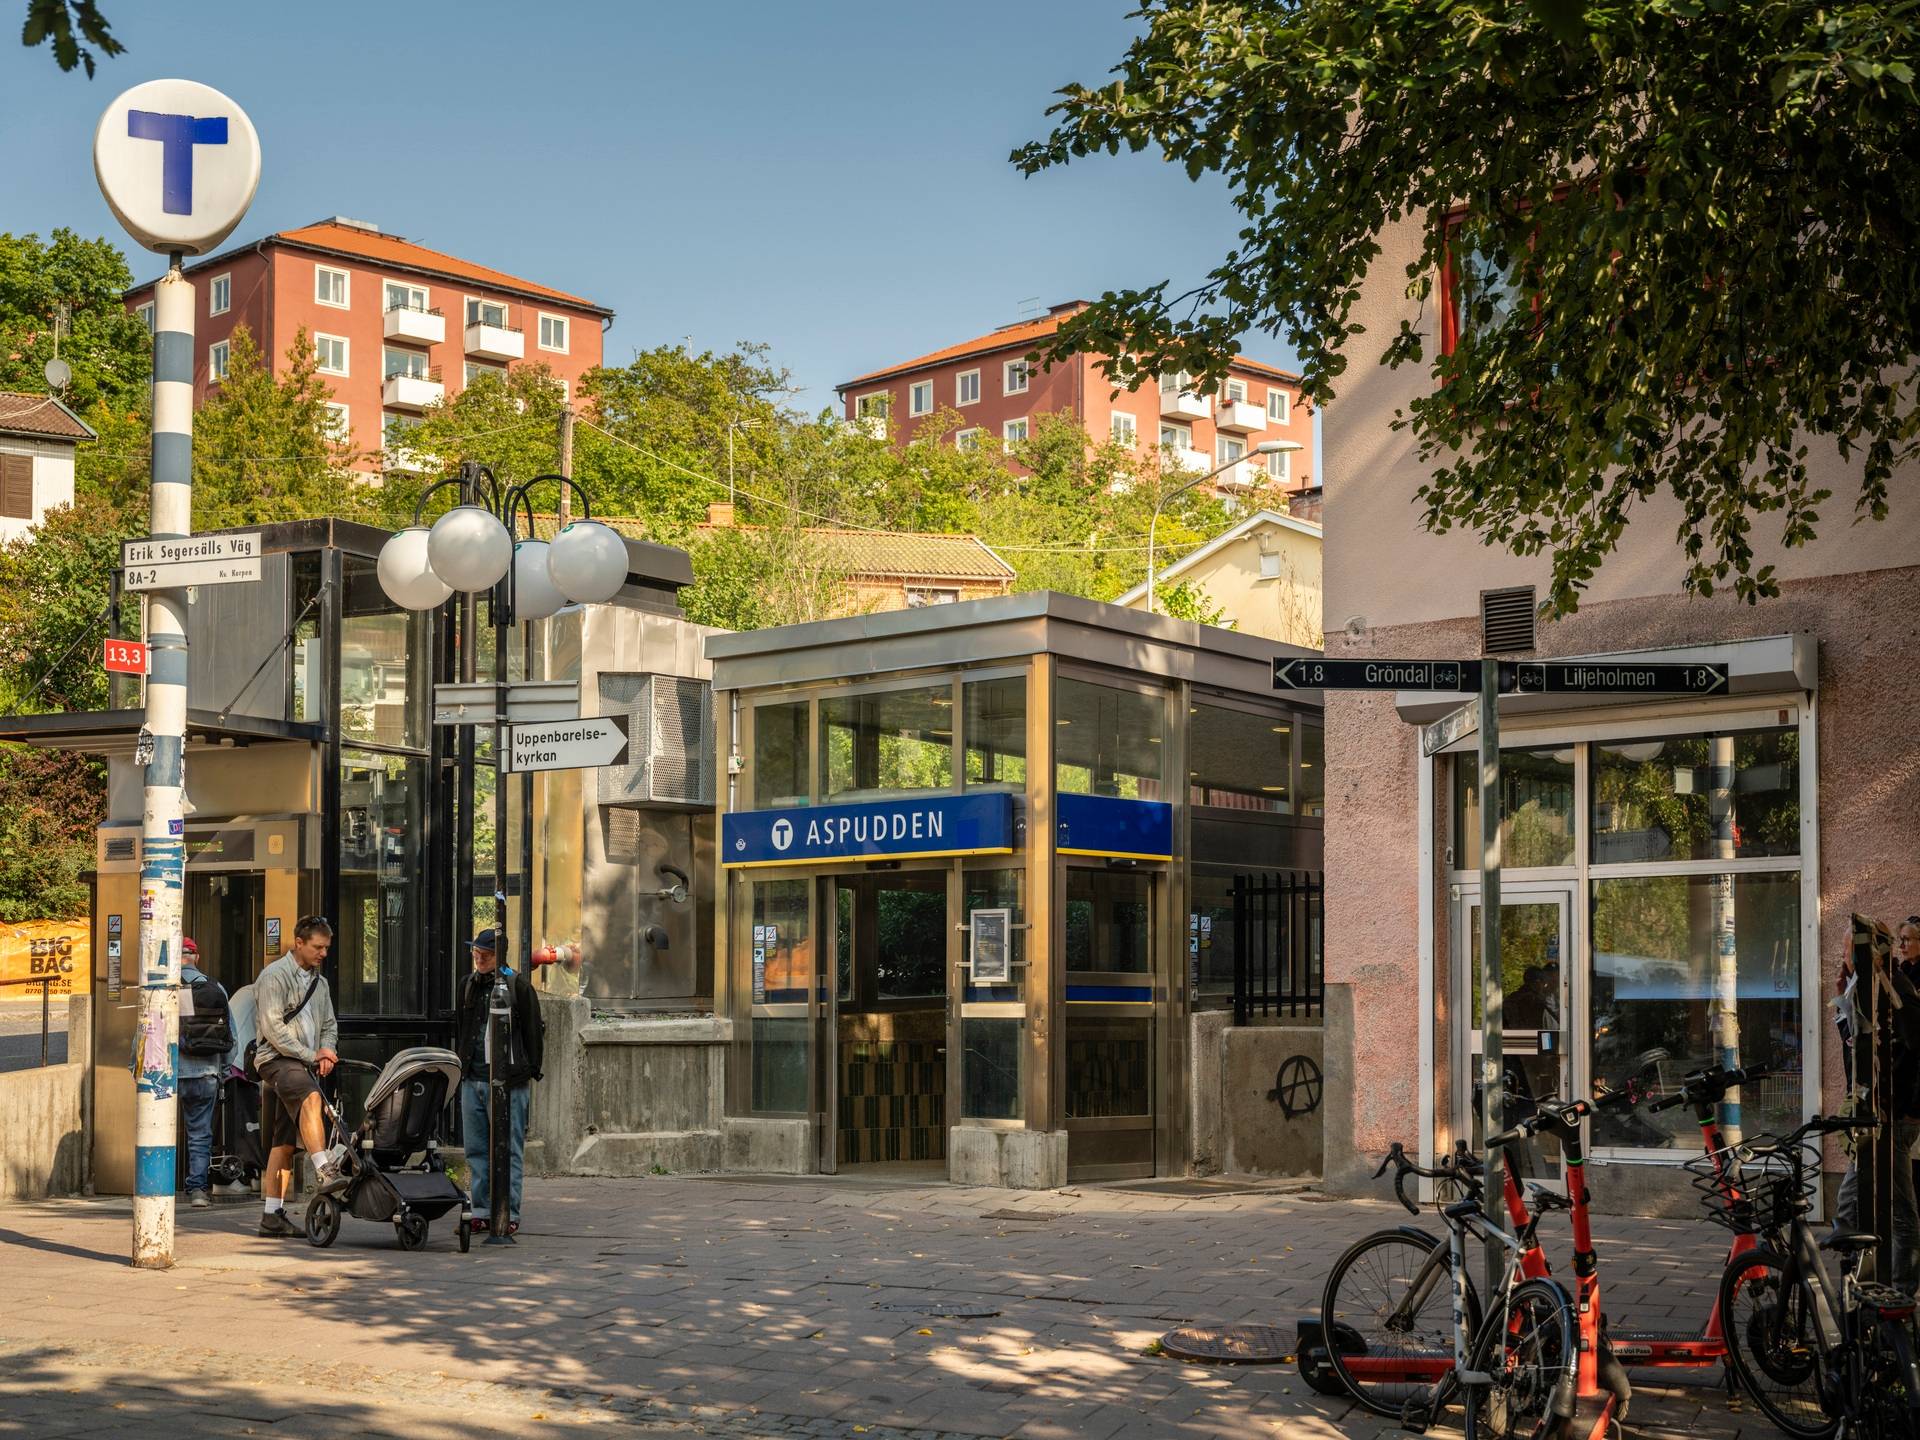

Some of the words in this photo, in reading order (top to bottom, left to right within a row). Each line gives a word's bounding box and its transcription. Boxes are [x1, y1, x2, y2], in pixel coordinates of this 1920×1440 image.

[128, 109, 228, 216] T
[130, 545, 153, 560] Erik
[161, 540, 222, 560] Segersälls
[230, 539, 251, 555] Väg
[129, 569, 157, 584] 8A-2
[108, 647, 141, 666] 13,3
[1299, 664, 1324, 684] 1,8
[1365, 664, 1428, 683] Gröndal
[1564, 667, 1656, 689] Liljeholmen
[1683, 669, 1707, 689] 1,8
[516, 728, 607, 747] Uppenbarelse-
[516, 750, 557, 765] kyrkan
[806, 811, 943, 846] ASPUDDEN
[30, 936, 72, 956] BIG
[30, 956, 72, 974] BAG
